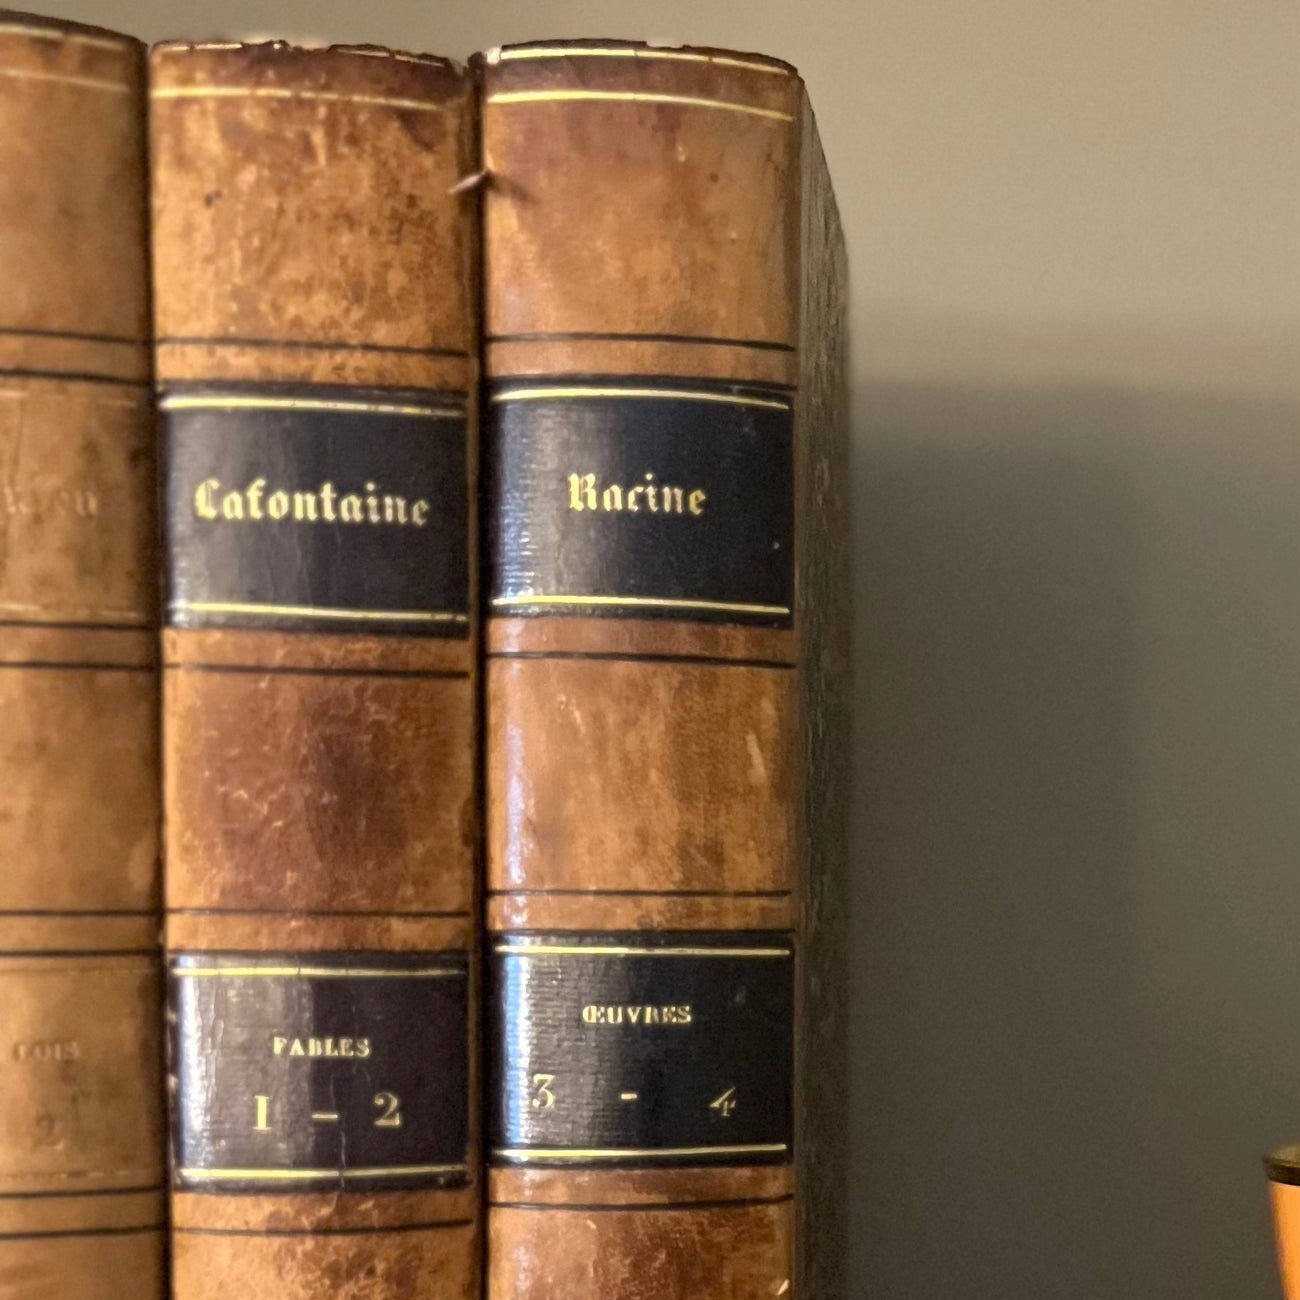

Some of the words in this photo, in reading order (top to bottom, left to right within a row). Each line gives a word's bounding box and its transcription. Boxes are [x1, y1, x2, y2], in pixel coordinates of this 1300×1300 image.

[194, 477, 430, 527] Lafontaine
[567, 472, 706, 516] Racine
[582, 1005, 693, 1025] ŒUVRES
[272, 1036, 370, 1057] FABLES
[374, 1092, 400, 1126] 2
[532, 1073, 556, 1109] 3
[709, 1087, 737, 1117] 4
